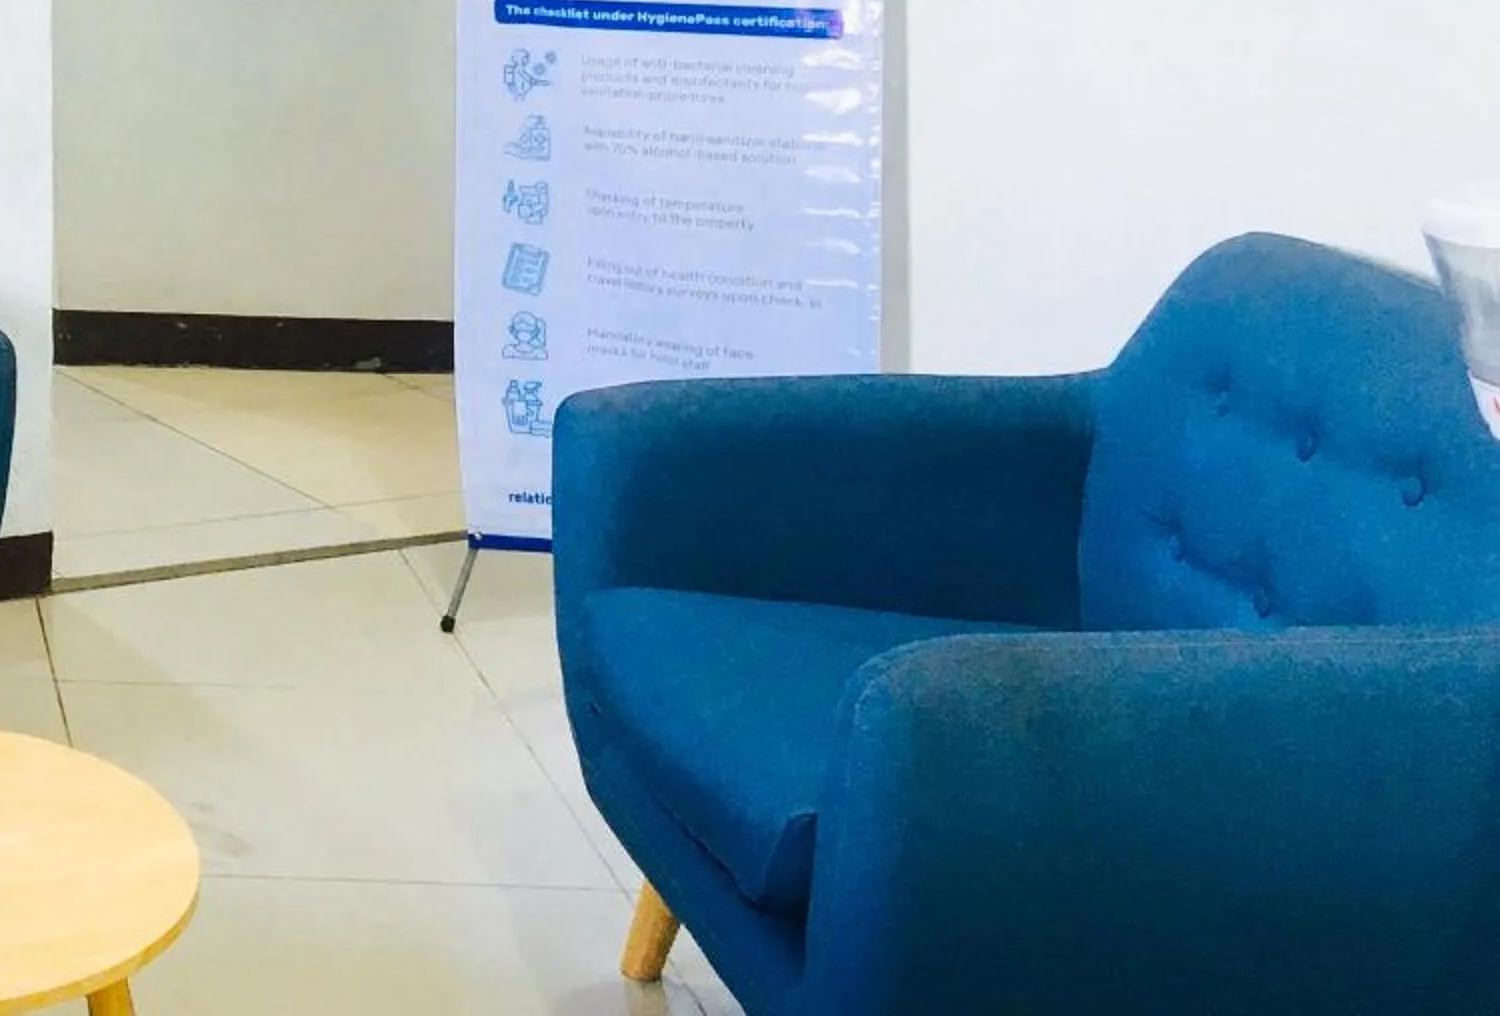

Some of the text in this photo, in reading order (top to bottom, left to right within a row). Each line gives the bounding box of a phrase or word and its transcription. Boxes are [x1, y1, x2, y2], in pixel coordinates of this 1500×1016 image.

[505, 4, 531, 17] The
[533, 6, 590, 20] checklist
[593, 9, 635, 22] under
[637, 11, 731, 27] HygienePass
